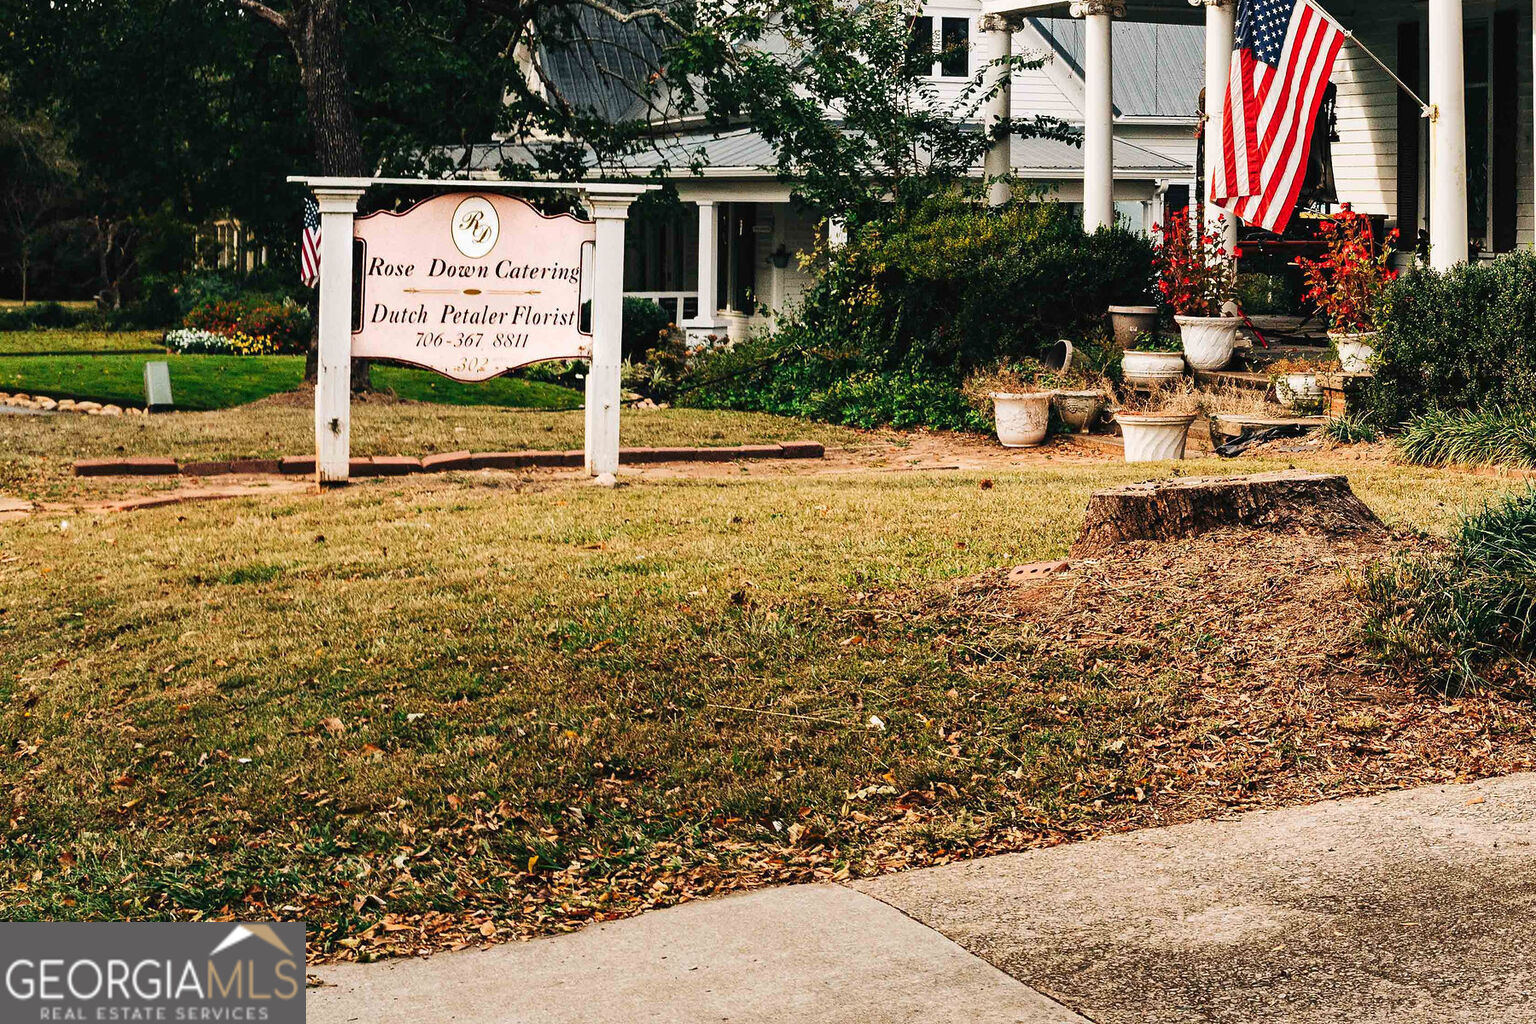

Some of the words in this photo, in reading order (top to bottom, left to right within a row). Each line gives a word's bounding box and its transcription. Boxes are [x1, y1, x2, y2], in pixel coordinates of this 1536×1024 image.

[368, 257, 415, 277] Rose
[428, 258, 489, 278] Down
[495, 259, 580, 283] Catering
[371, 304, 428, 324] Dutch
[440, 304, 510, 325] Petaler
[511, 305, 576, 326] Florist
[415, 332, 484, 348] 706-367
[492, 333, 530, 349] 8811
